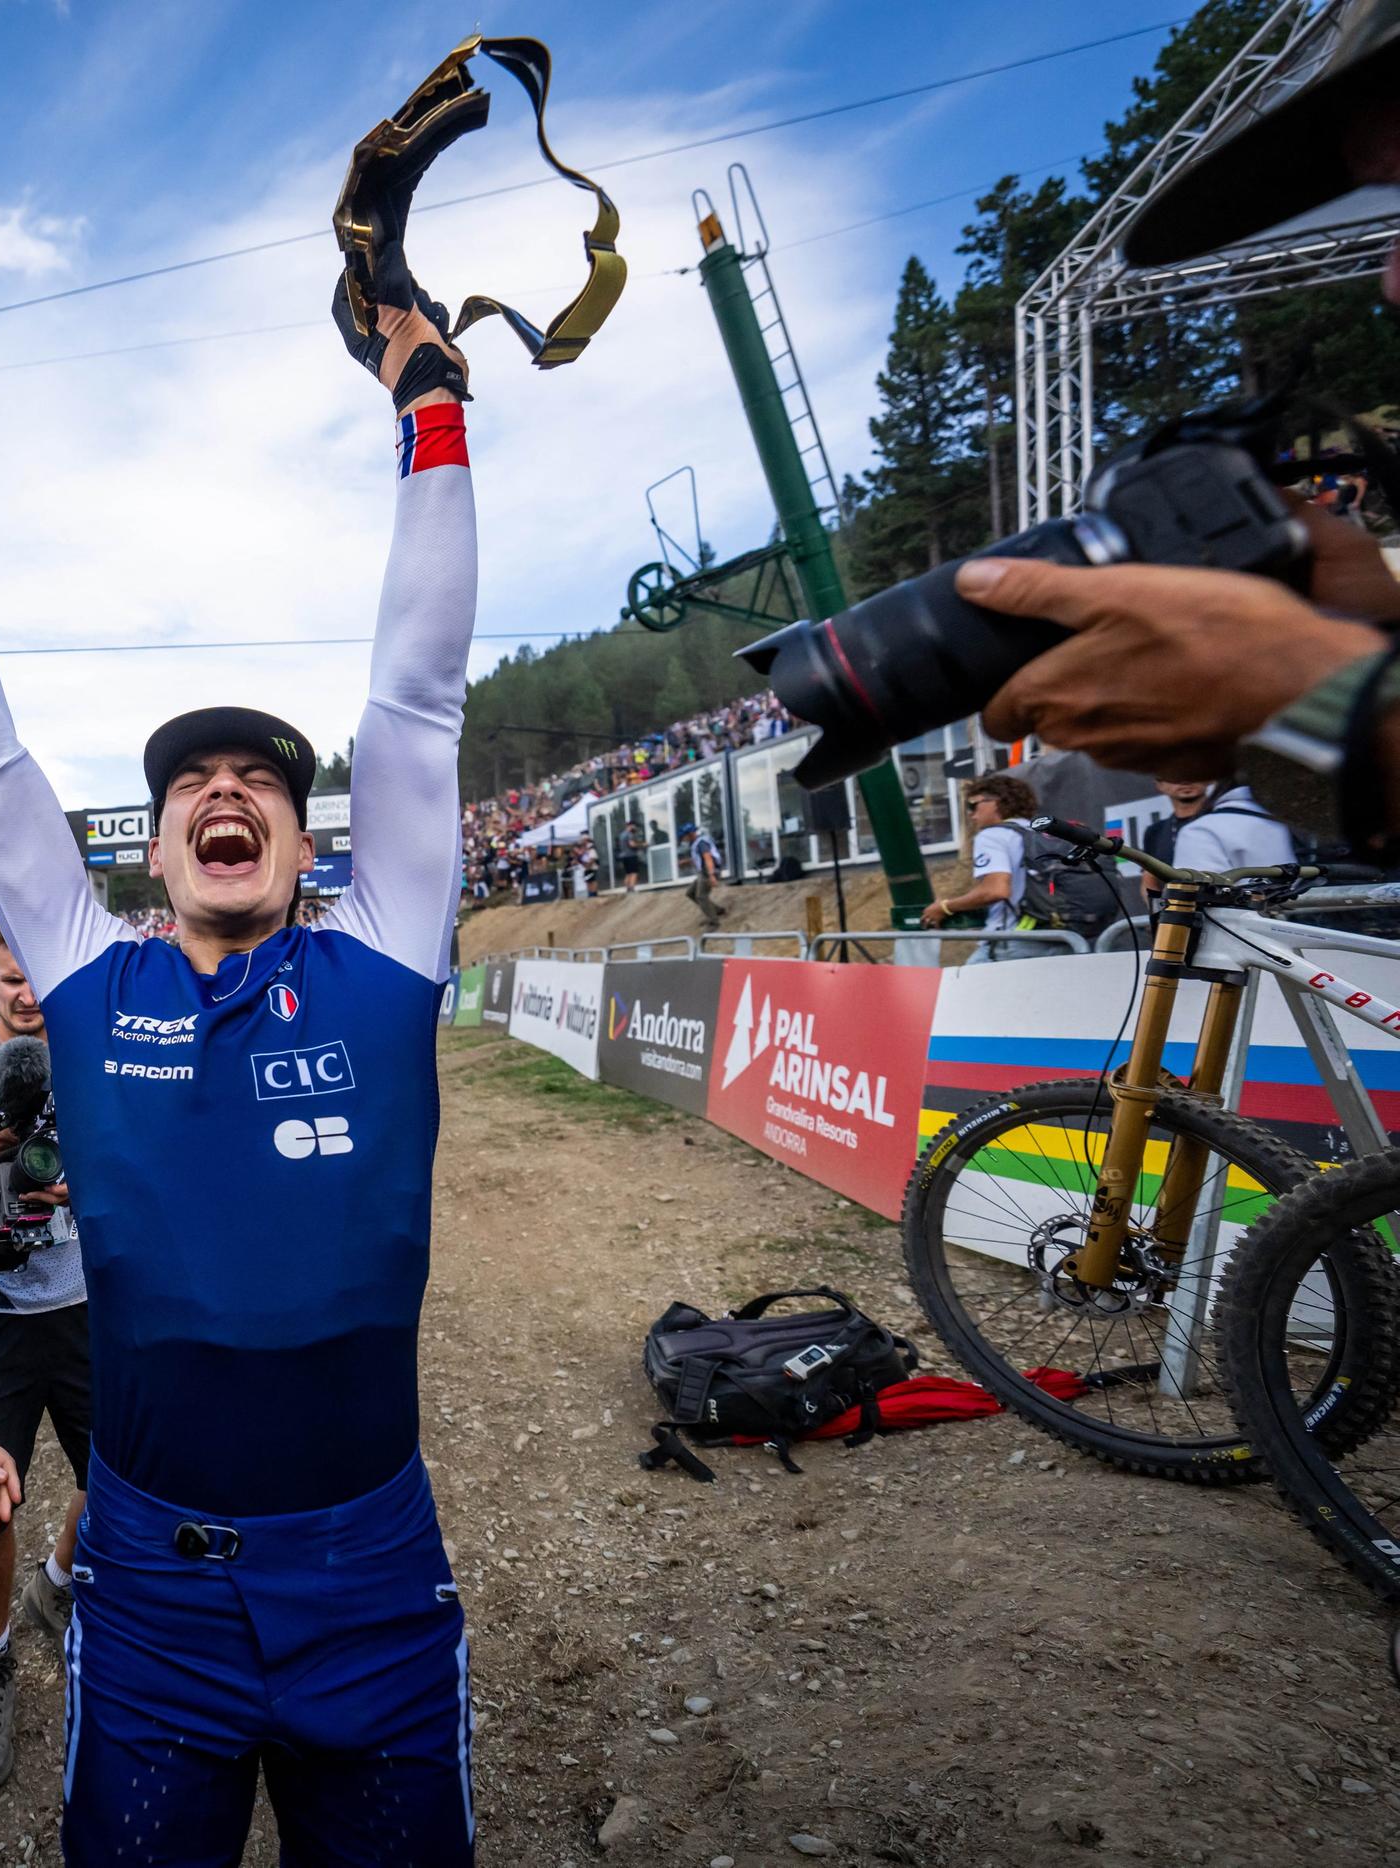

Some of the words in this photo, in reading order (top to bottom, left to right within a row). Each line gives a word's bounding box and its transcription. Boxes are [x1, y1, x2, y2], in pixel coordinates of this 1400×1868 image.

[98, 817, 144, 838] UCI
[112, 1028, 159, 1044] FACTORY
[158, 1034, 195, 1046] RACING
[115, 1010, 200, 1035] TREK
[627, 999, 705, 1054] Andorra
[774, 1008, 819, 1056] PAL
[120, 1063, 194, 1080] FACOM
[264, 1053, 344, 1089] CIC
[768, 1050, 896, 1128] ARINSAL
[764, 1121, 807, 1157] ANDORRA
[815, 1114, 858, 1149] Resorts
[958, 1109, 1001, 1137] MICHELIN
